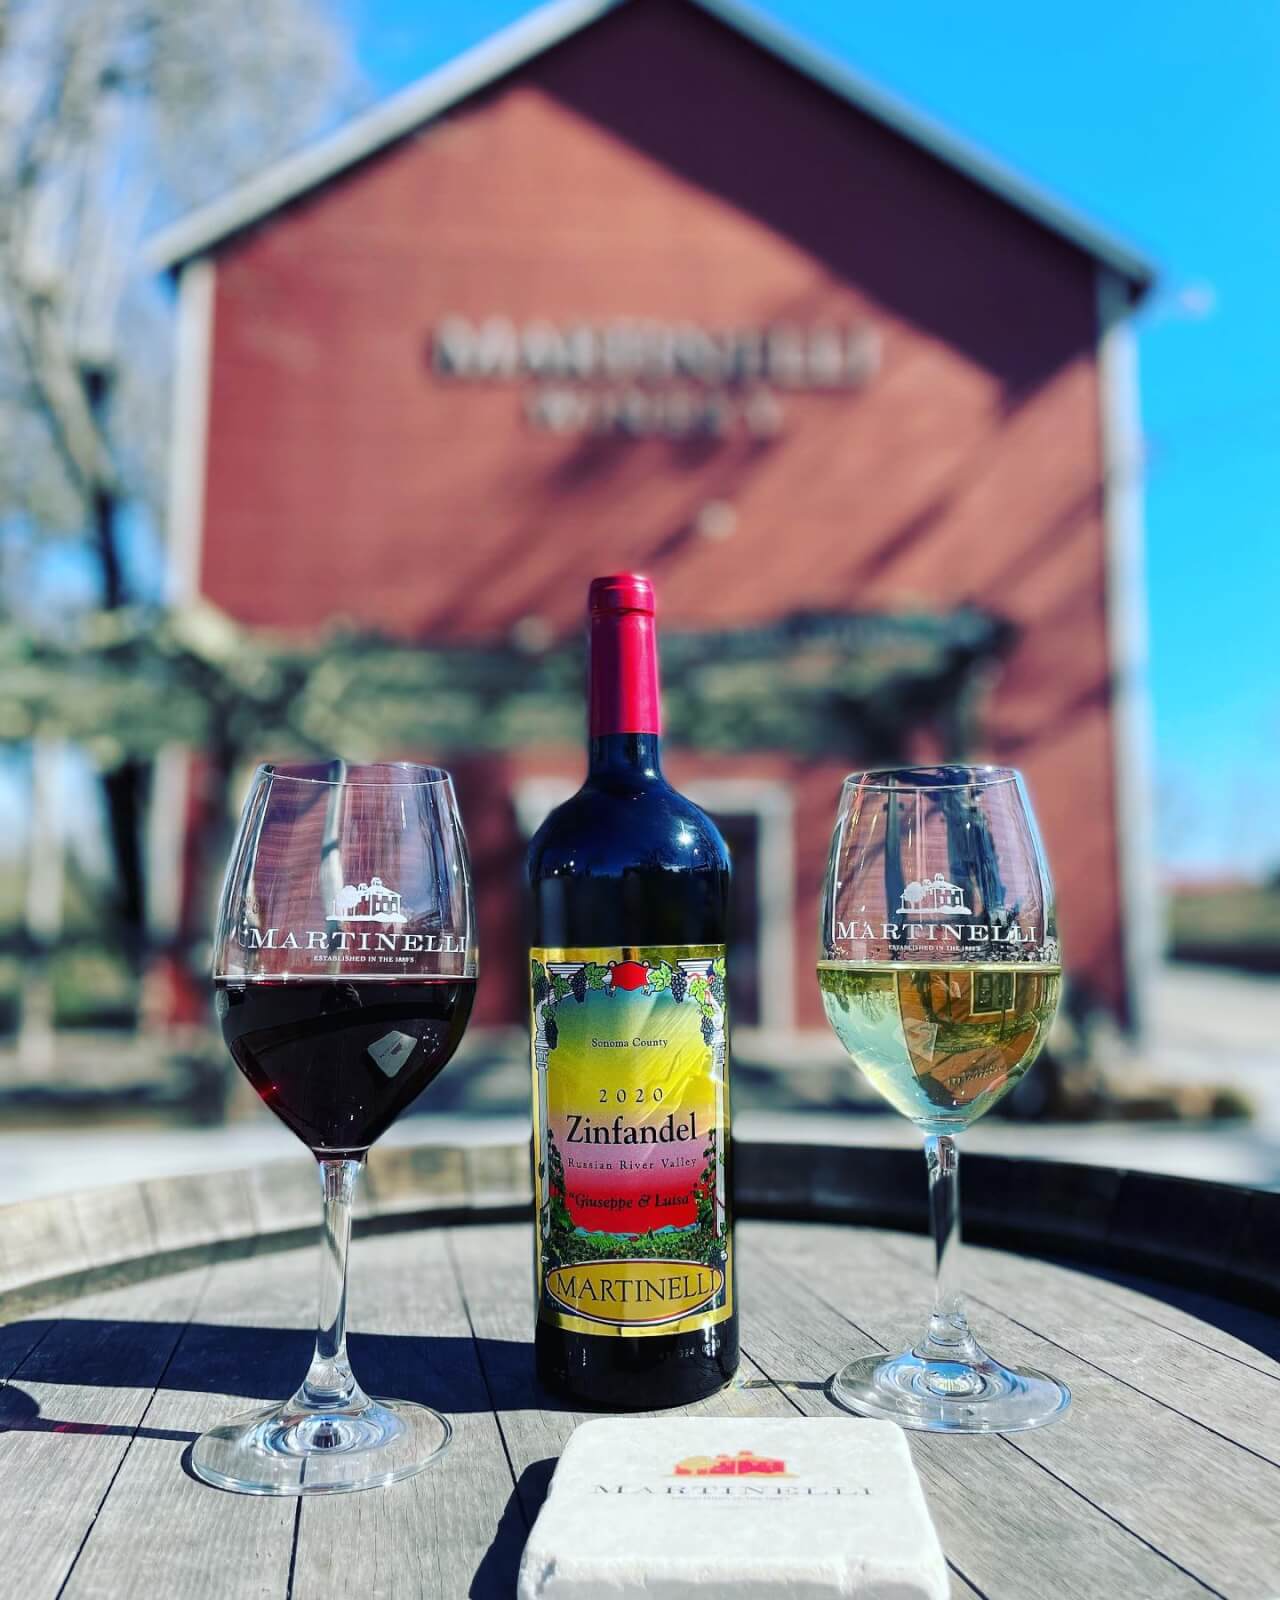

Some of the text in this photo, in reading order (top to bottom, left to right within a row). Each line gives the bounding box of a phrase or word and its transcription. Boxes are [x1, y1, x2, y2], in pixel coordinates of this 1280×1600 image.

[836, 921, 1037, 943] MARTINELLI
[248, 928, 466, 953] MARTINELLI
[313, 955, 366, 963] ESTABLISHED
[591, 1037, 668, 1048] Sonoma County
[599, 1088, 663, 1103] 2020
[566, 1112, 698, 1145] Zinfandel
[568, 1157, 697, 1170] Russian River Valley
[555, 1270, 718, 1303] MARTINELLI
[591, 1486, 873, 1496] MARTINELLI
